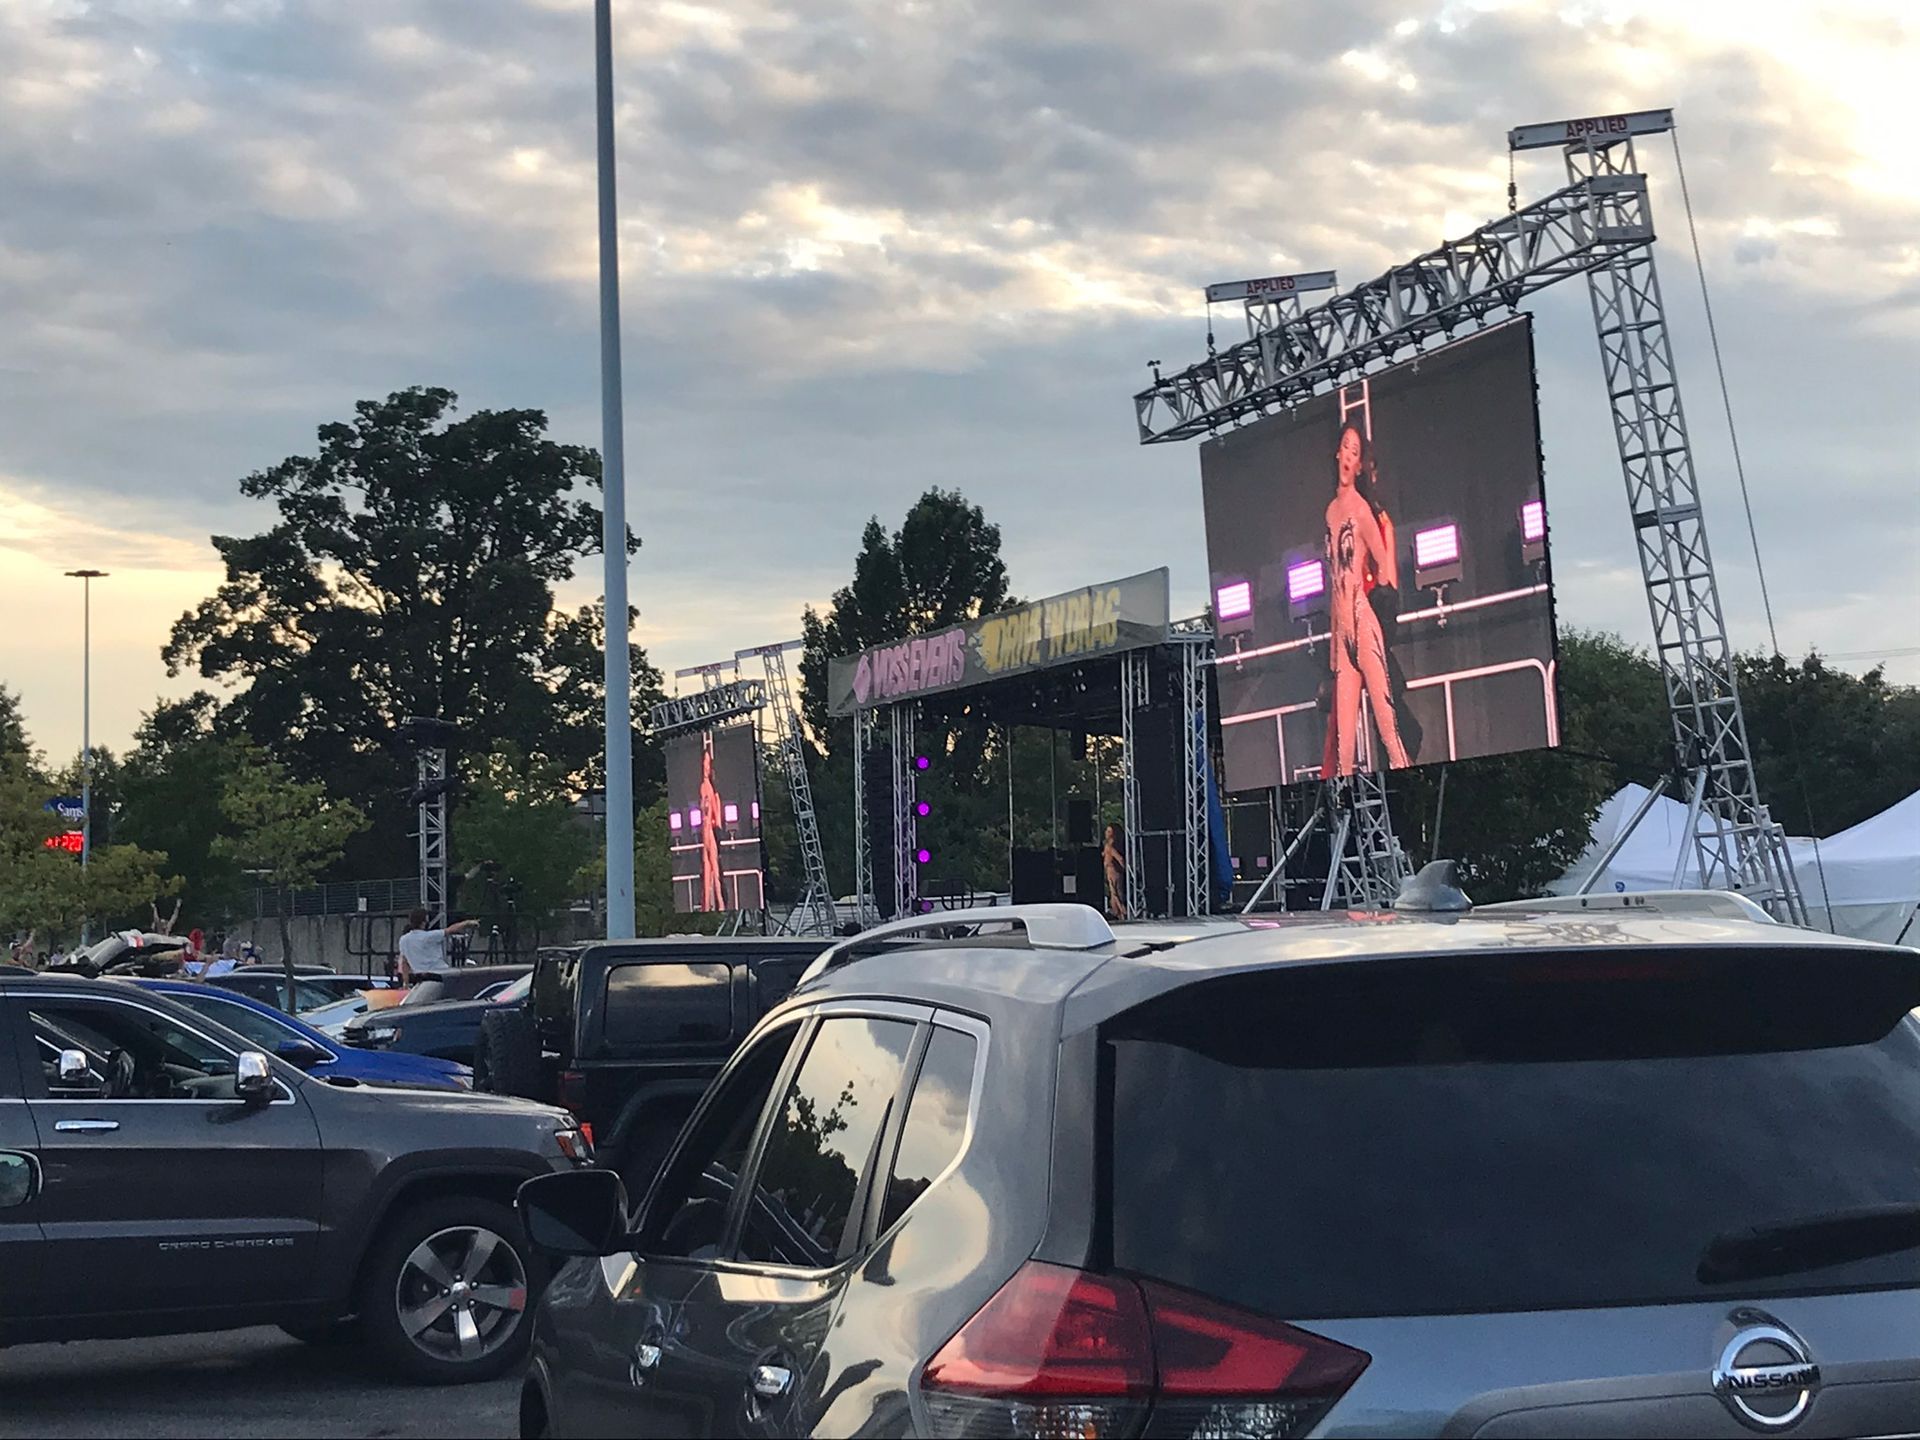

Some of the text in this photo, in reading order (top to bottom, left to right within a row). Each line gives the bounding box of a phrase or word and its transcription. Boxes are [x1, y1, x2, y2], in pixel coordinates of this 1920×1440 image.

[1566, 117, 1627, 137] APPLIED
[1246, 278, 1295, 294] APPLIED
[1729, 1368, 1809, 1389] NISSAN
